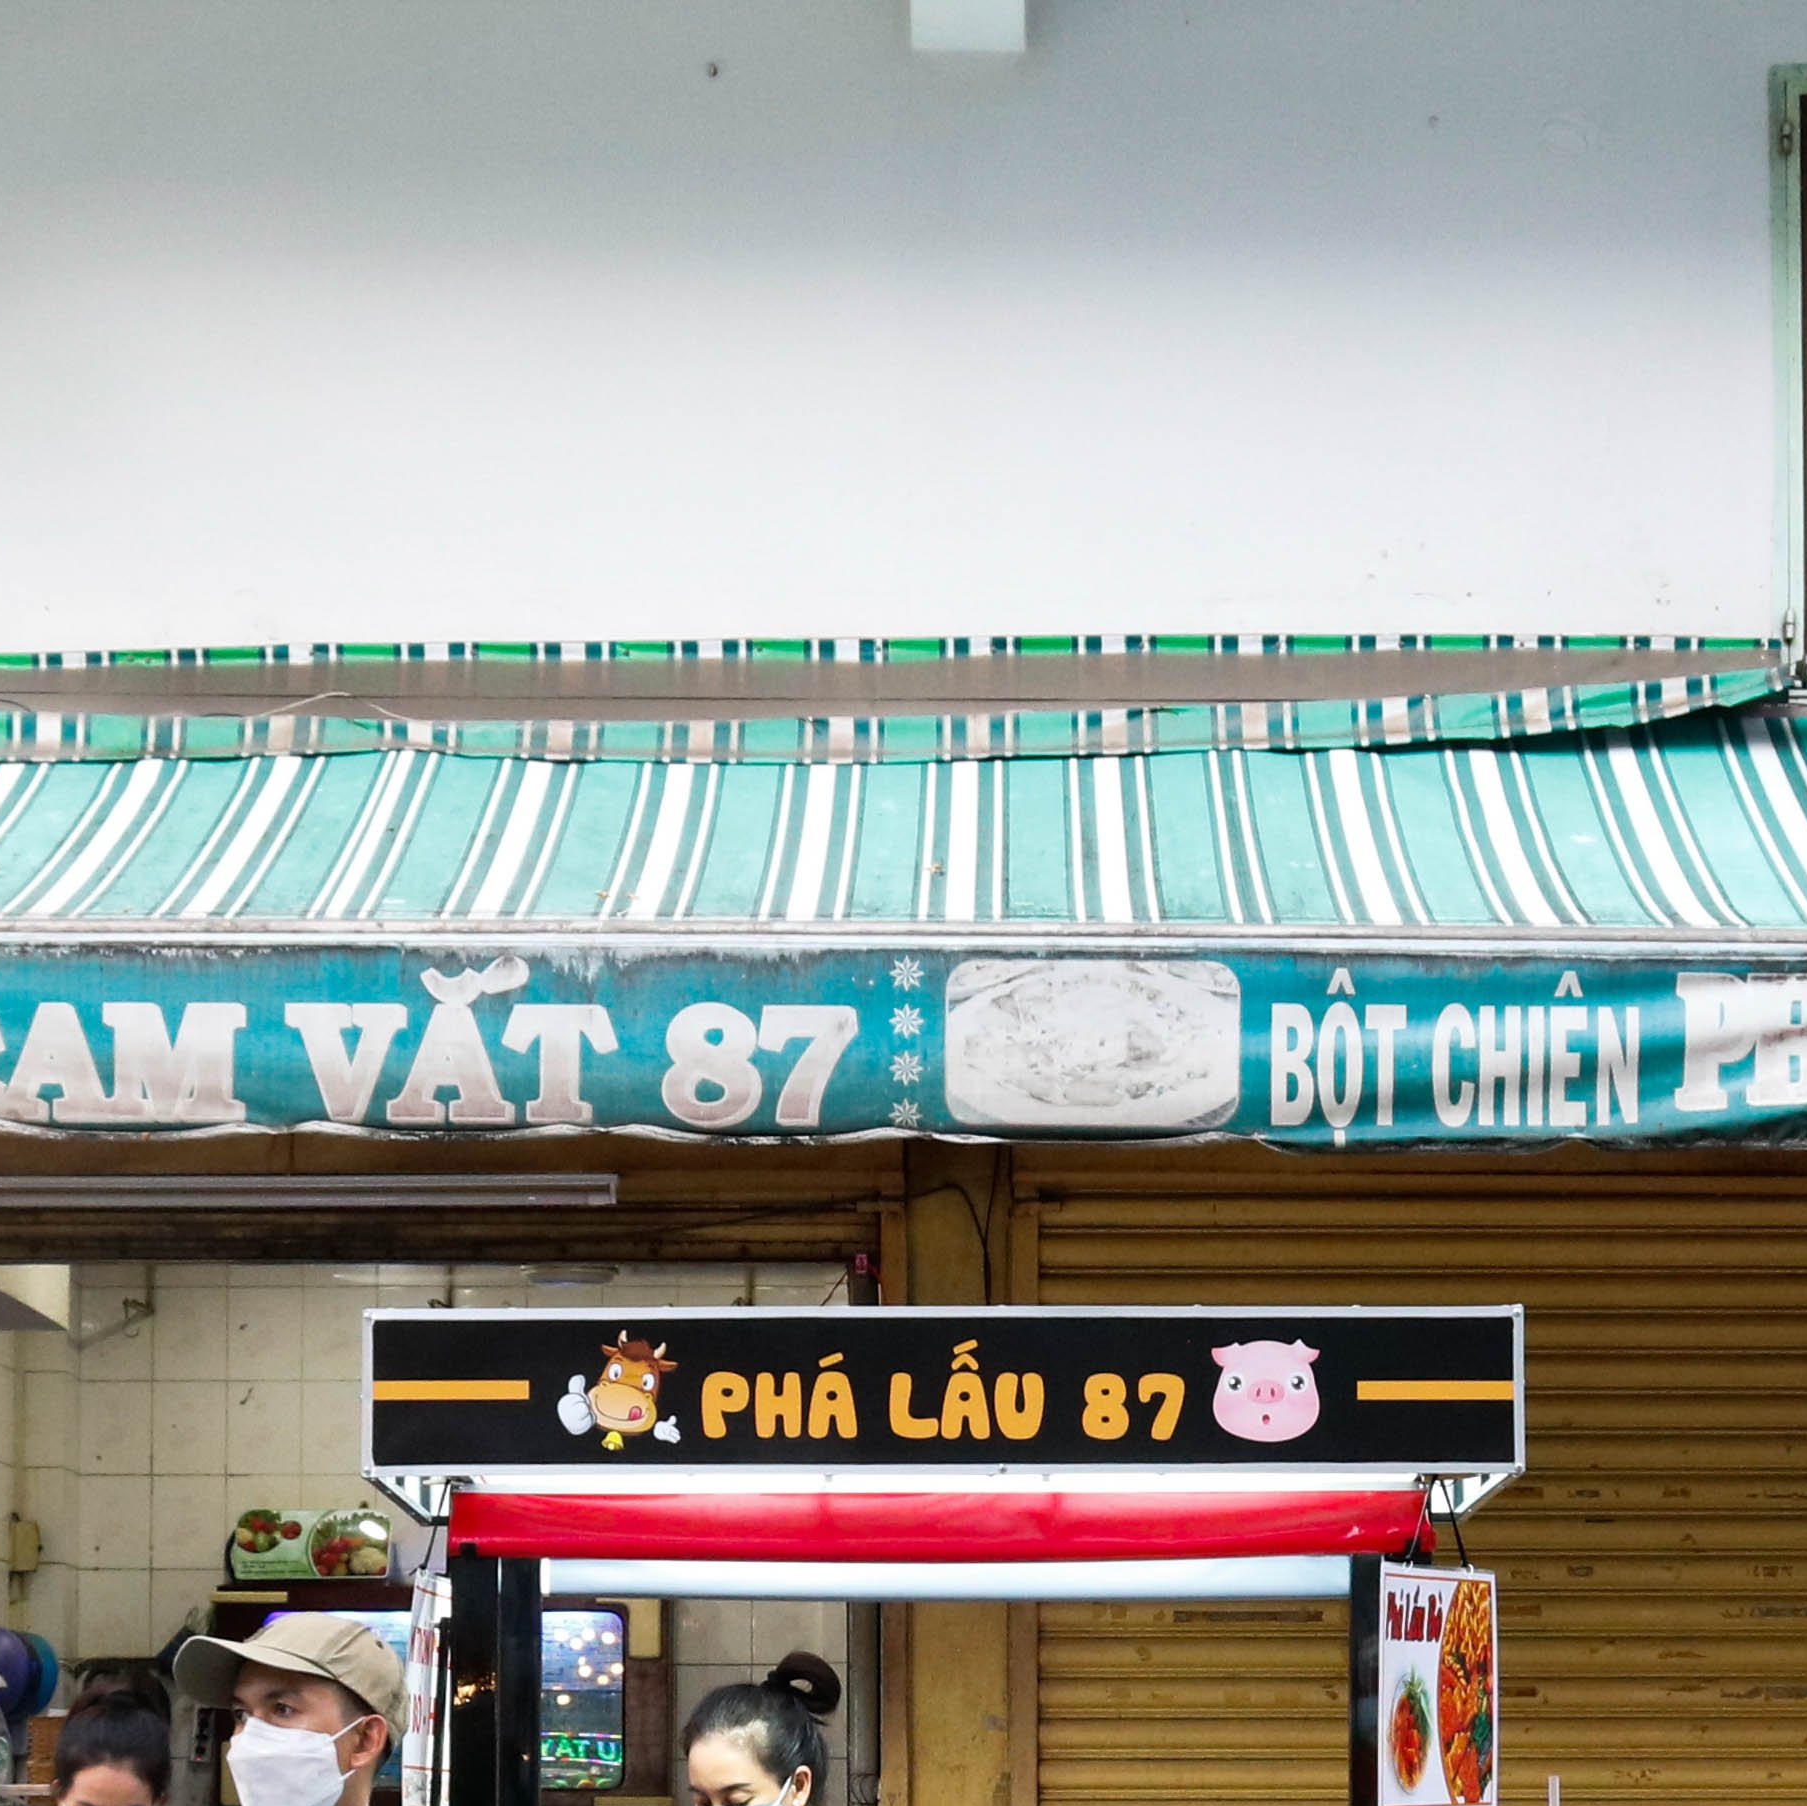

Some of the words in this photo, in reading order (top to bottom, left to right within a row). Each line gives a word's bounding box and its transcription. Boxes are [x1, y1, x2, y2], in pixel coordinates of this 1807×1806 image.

[660, 1001, 856, 1128] 87
[1271, 966, 1407, 1143] BỘT
[1431, 971, 1641, 1132] CHIÊN
[700, 1353, 859, 1441] PHÁ
[888, 1339, 1044, 1442] LẤU
[1081, 1371, 1187, 1443] 87
